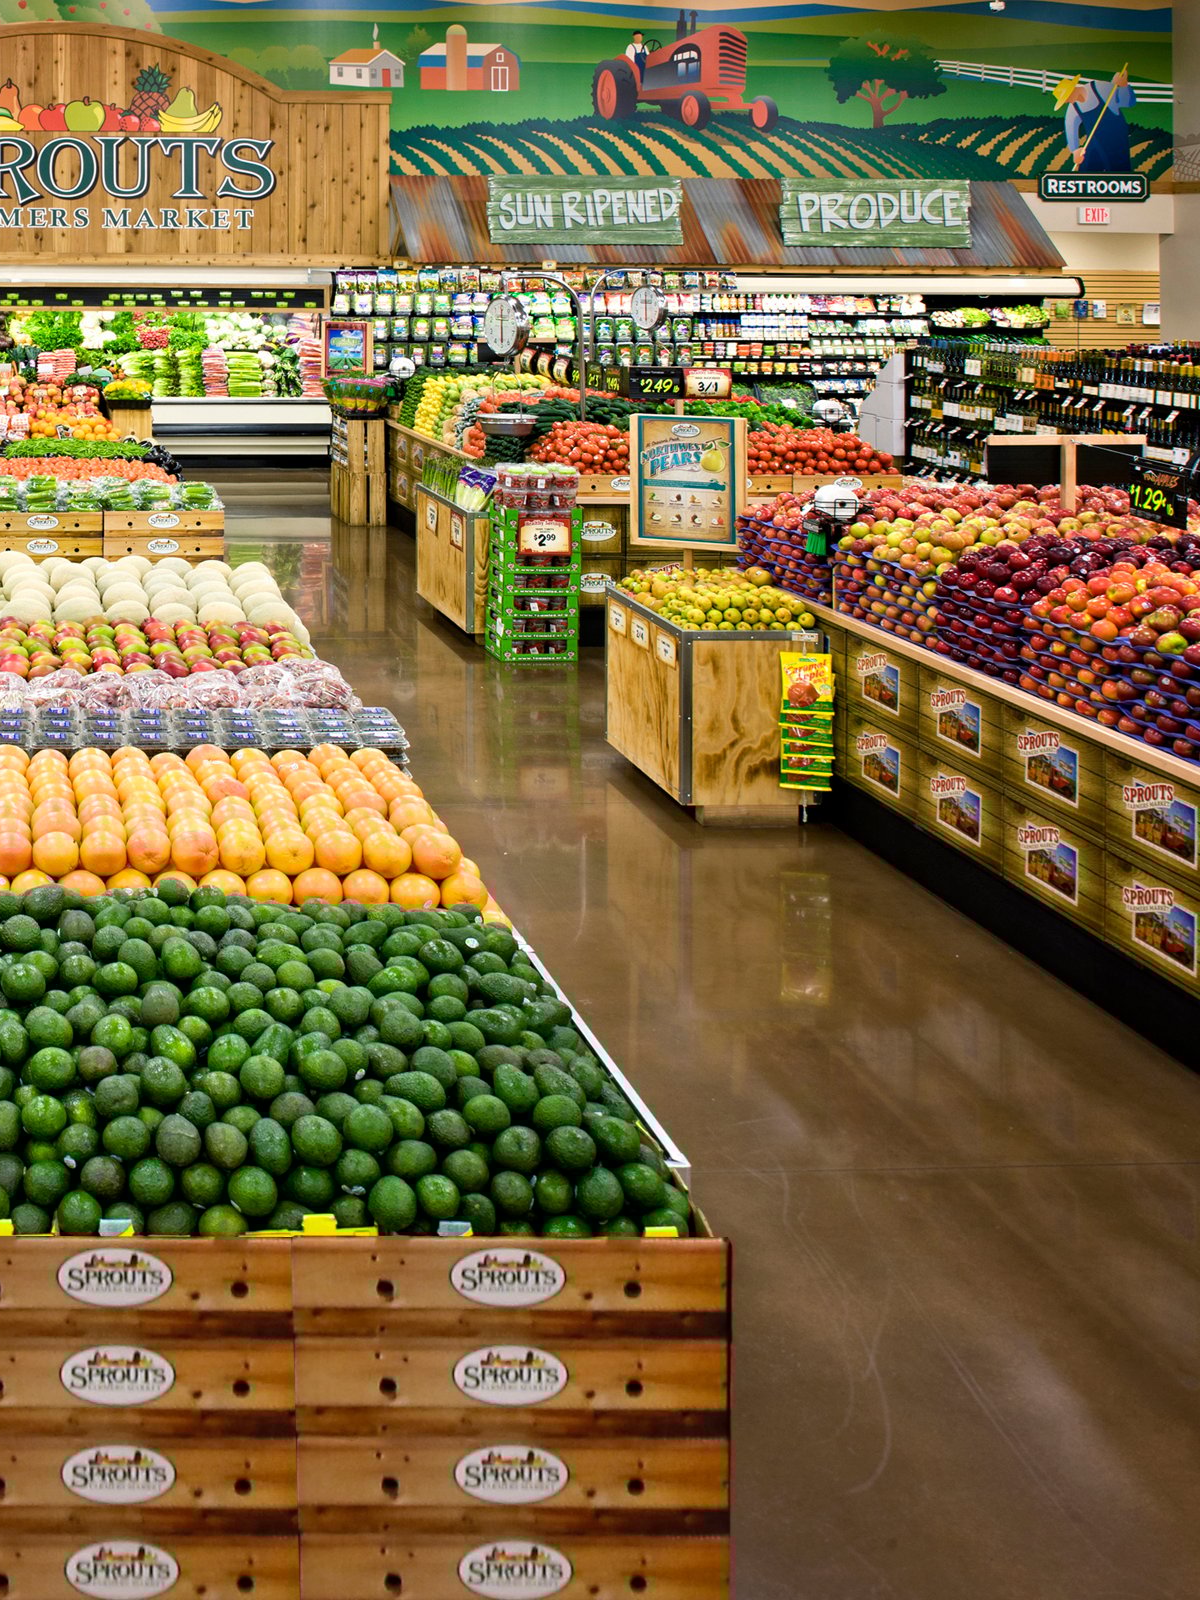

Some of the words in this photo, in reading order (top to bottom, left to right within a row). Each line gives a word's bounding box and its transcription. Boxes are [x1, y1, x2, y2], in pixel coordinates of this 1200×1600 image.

[1047, 178, 1142, 194] RESTROOMS
[102, 208, 255, 230] MARKET
[498, 193, 556, 231] SUN
[562, 188, 679, 230] RIPENED
[796, 188, 965, 234] PRODUCE
[1085, 207, 1106, 222] EXIT
[640, 378, 673, 393] $2.49
[697, 381, 719, 392] 3/1
[641, 442, 708, 465] NORTHWEST
[650, 451, 703, 478] PEARS
[857, 654, 887, 671] SPROUTS
[931, 690, 965, 707] SPROUTS
[857, 735, 887, 751] SPROUTS
[1018, 733, 1059, 750] SPROUTS
[931, 777, 966, 792] SPROUTS
[1124, 785, 1174, 802] SPROUTS
[1018, 828, 1059, 843] SPROUTS
[1124, 888, 1174, 906] SPROUTS
[68, 1268, 163, 1291] SPROUTS
[461, 1268, 556, 1291] SPROUTS
[71, 1366, 166, 1389] SPROUTS
[464, 1366, 559, 1389] SPROUTS
[72, 1465, 167, 1488] SPROUTS
[465, 1465, 560, 1488] SPROUTS
[75, 1561, 170, 1584] SPROUTS
[468, 1561, 563, 1584] SPROUTS
